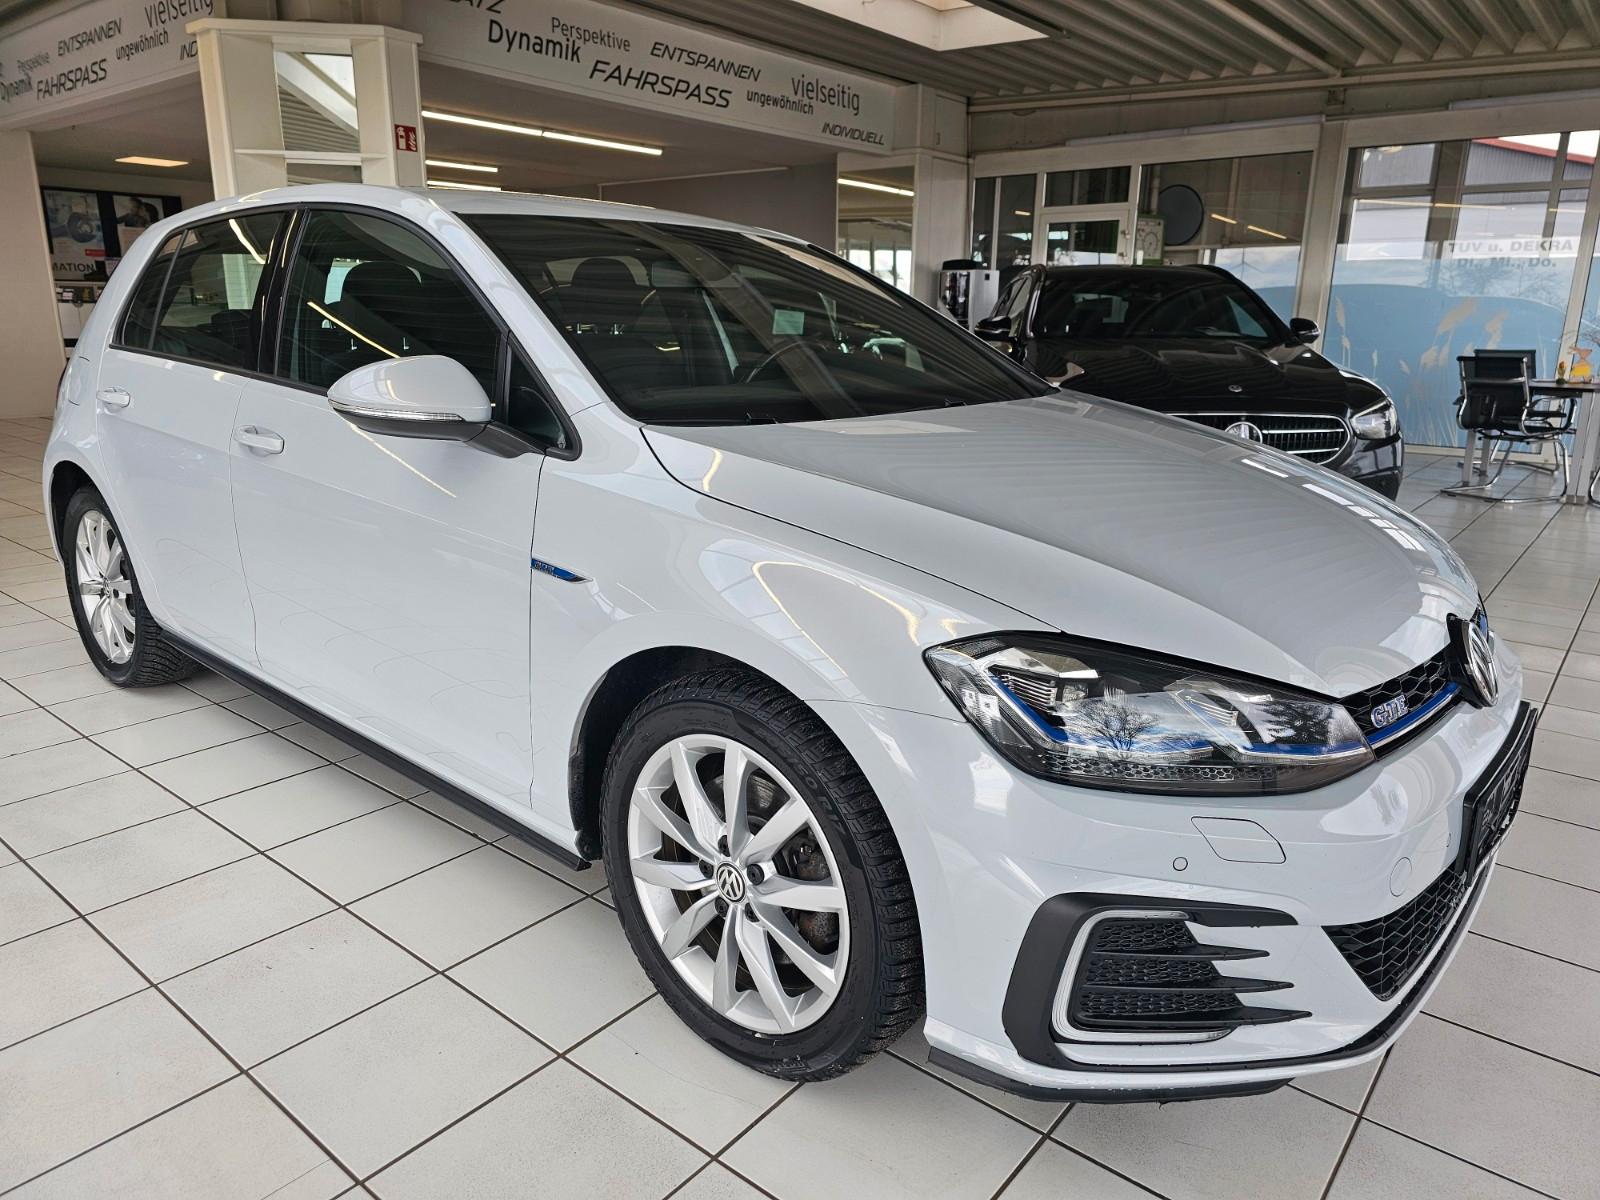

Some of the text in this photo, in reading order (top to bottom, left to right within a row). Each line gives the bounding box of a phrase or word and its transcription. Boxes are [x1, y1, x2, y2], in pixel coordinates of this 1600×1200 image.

[57, 17, 122, 56] ENTSPANNEN
[116, 27, 169, 60] ungewöhnlich
[488, 19, 581, 63] Dynamik
[551, 16, 631, 52] Perspektive
[37, 58, 108, 101] FAHRSPASS
[650, 41, 762, 82] ENTSPANNEN
[589, 60, 733, 109] FAHRSPASS
[746, 89, 814, 116] ungewöhnlich
[821, 122, 885, 146] INDIVIDUELL
[1510, 240, 1573, 252] DEKRA
[1371, 694, 1408, 728] GTE
